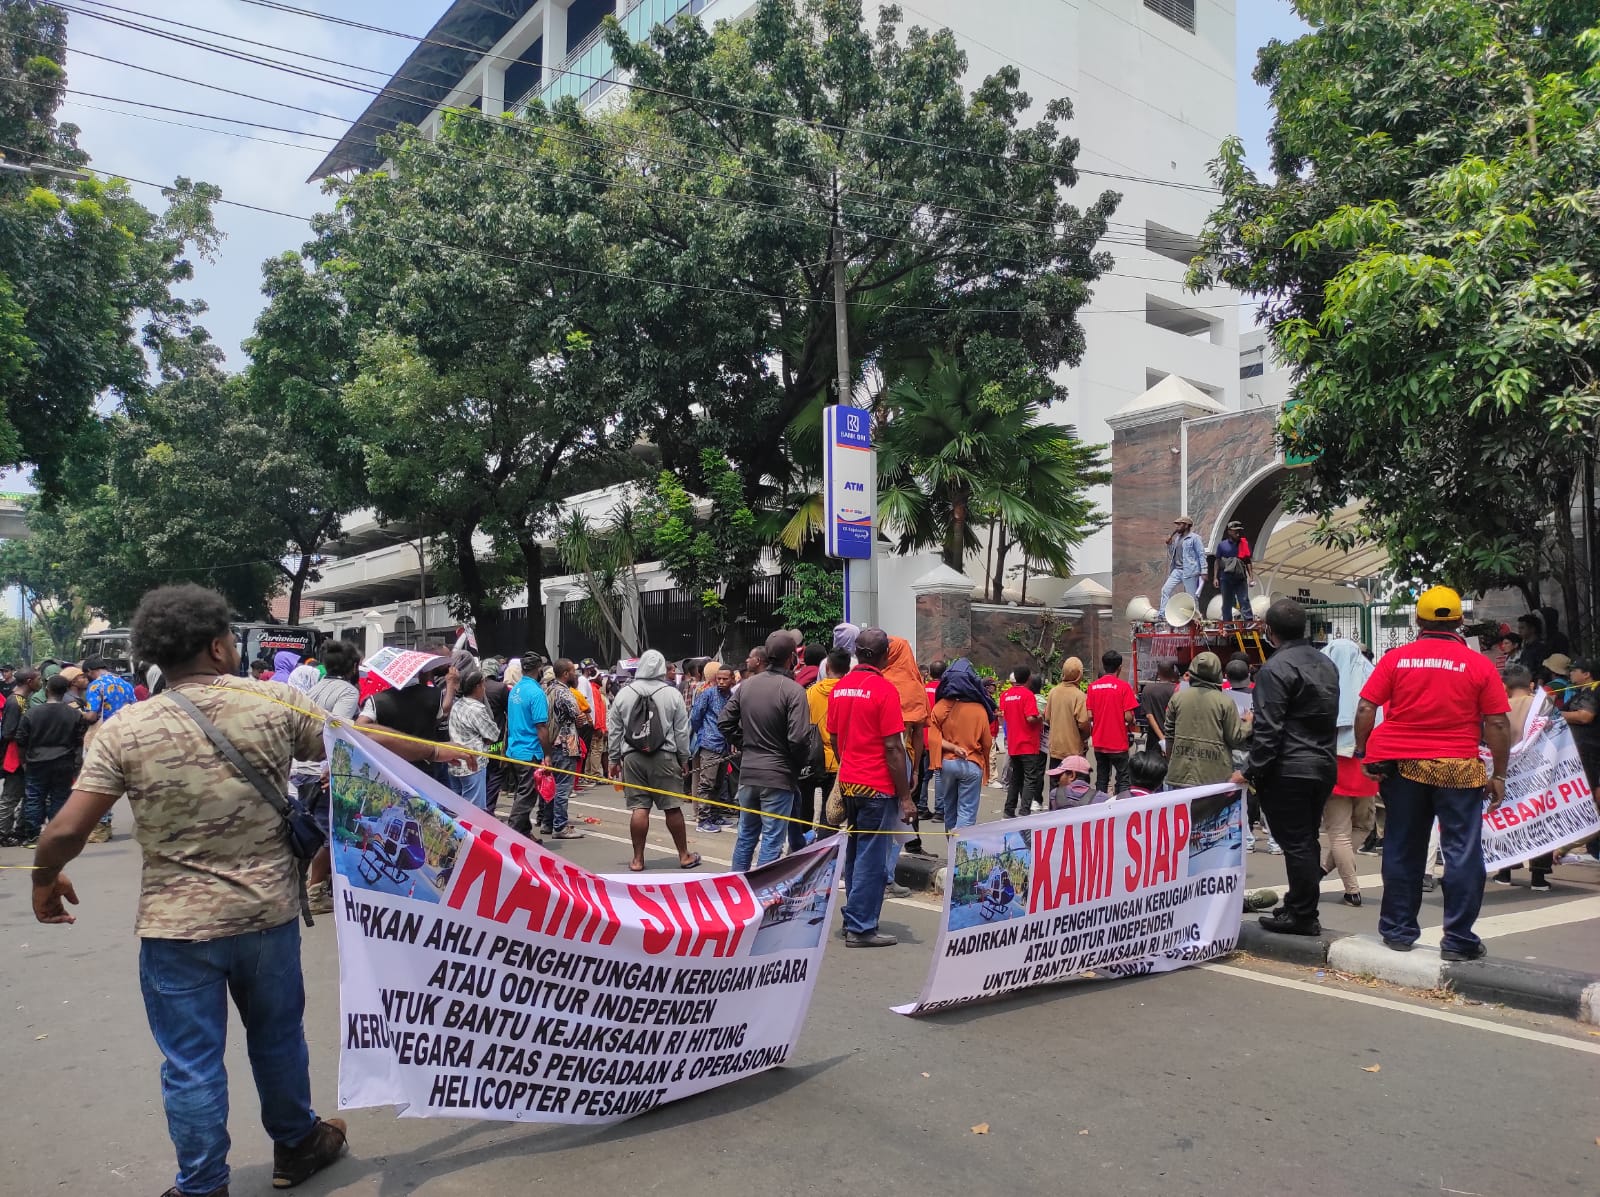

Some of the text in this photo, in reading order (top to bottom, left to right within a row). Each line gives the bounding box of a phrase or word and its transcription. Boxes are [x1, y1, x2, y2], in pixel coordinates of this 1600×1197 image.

[844, 481, 864, 492] ATM
[1482, 790, 1557, 832] TEBANG
[447, 820, 755, 957] KAMI SIAP
[1029, 803, 1191, 914] KAMI SIAP
[945, 926, 1018, 957] HADIRKAN
[1019, 918, 1050, 944] AHLI
[1052, 896, 1143, 936] PENGHITUNGAN
[1145, 882, 1194, 914] KERUGIAN
[1024, 911, 1175, 964] ATAU ODITUR INDEPENDEN
[423, 918, 487, 957] AHLI
[487, 935, 672, 994] PENGHITUNGAN
[670, 966, 757, 995] KERUGIAN
[755, 958, 808, 988] NEGARA
[983, 966, 1032, 991] UNTUK
[1032, 956, 1077, 981] BANTU
[1077, 939, 1147, 966] KEJAKSAAN
[1148, 935, 1161, 953] RI
[379, 988, 748, 1056] NTUK BANTU KEJAKSAAN RI HITUNG
[427, 960, 718, 1025] ATAU ODITUR INDEPENDEN
[476, 1042, 542, 1077] ATAS
[543, 1053, 673, 1085] PENGADAAN
[671, 1058, 687, 1083] &
[688, 1043, 790, 1081] OPERASIONAL
[428, 1074, 668, 1117] HELICOPTER PESAWAT
